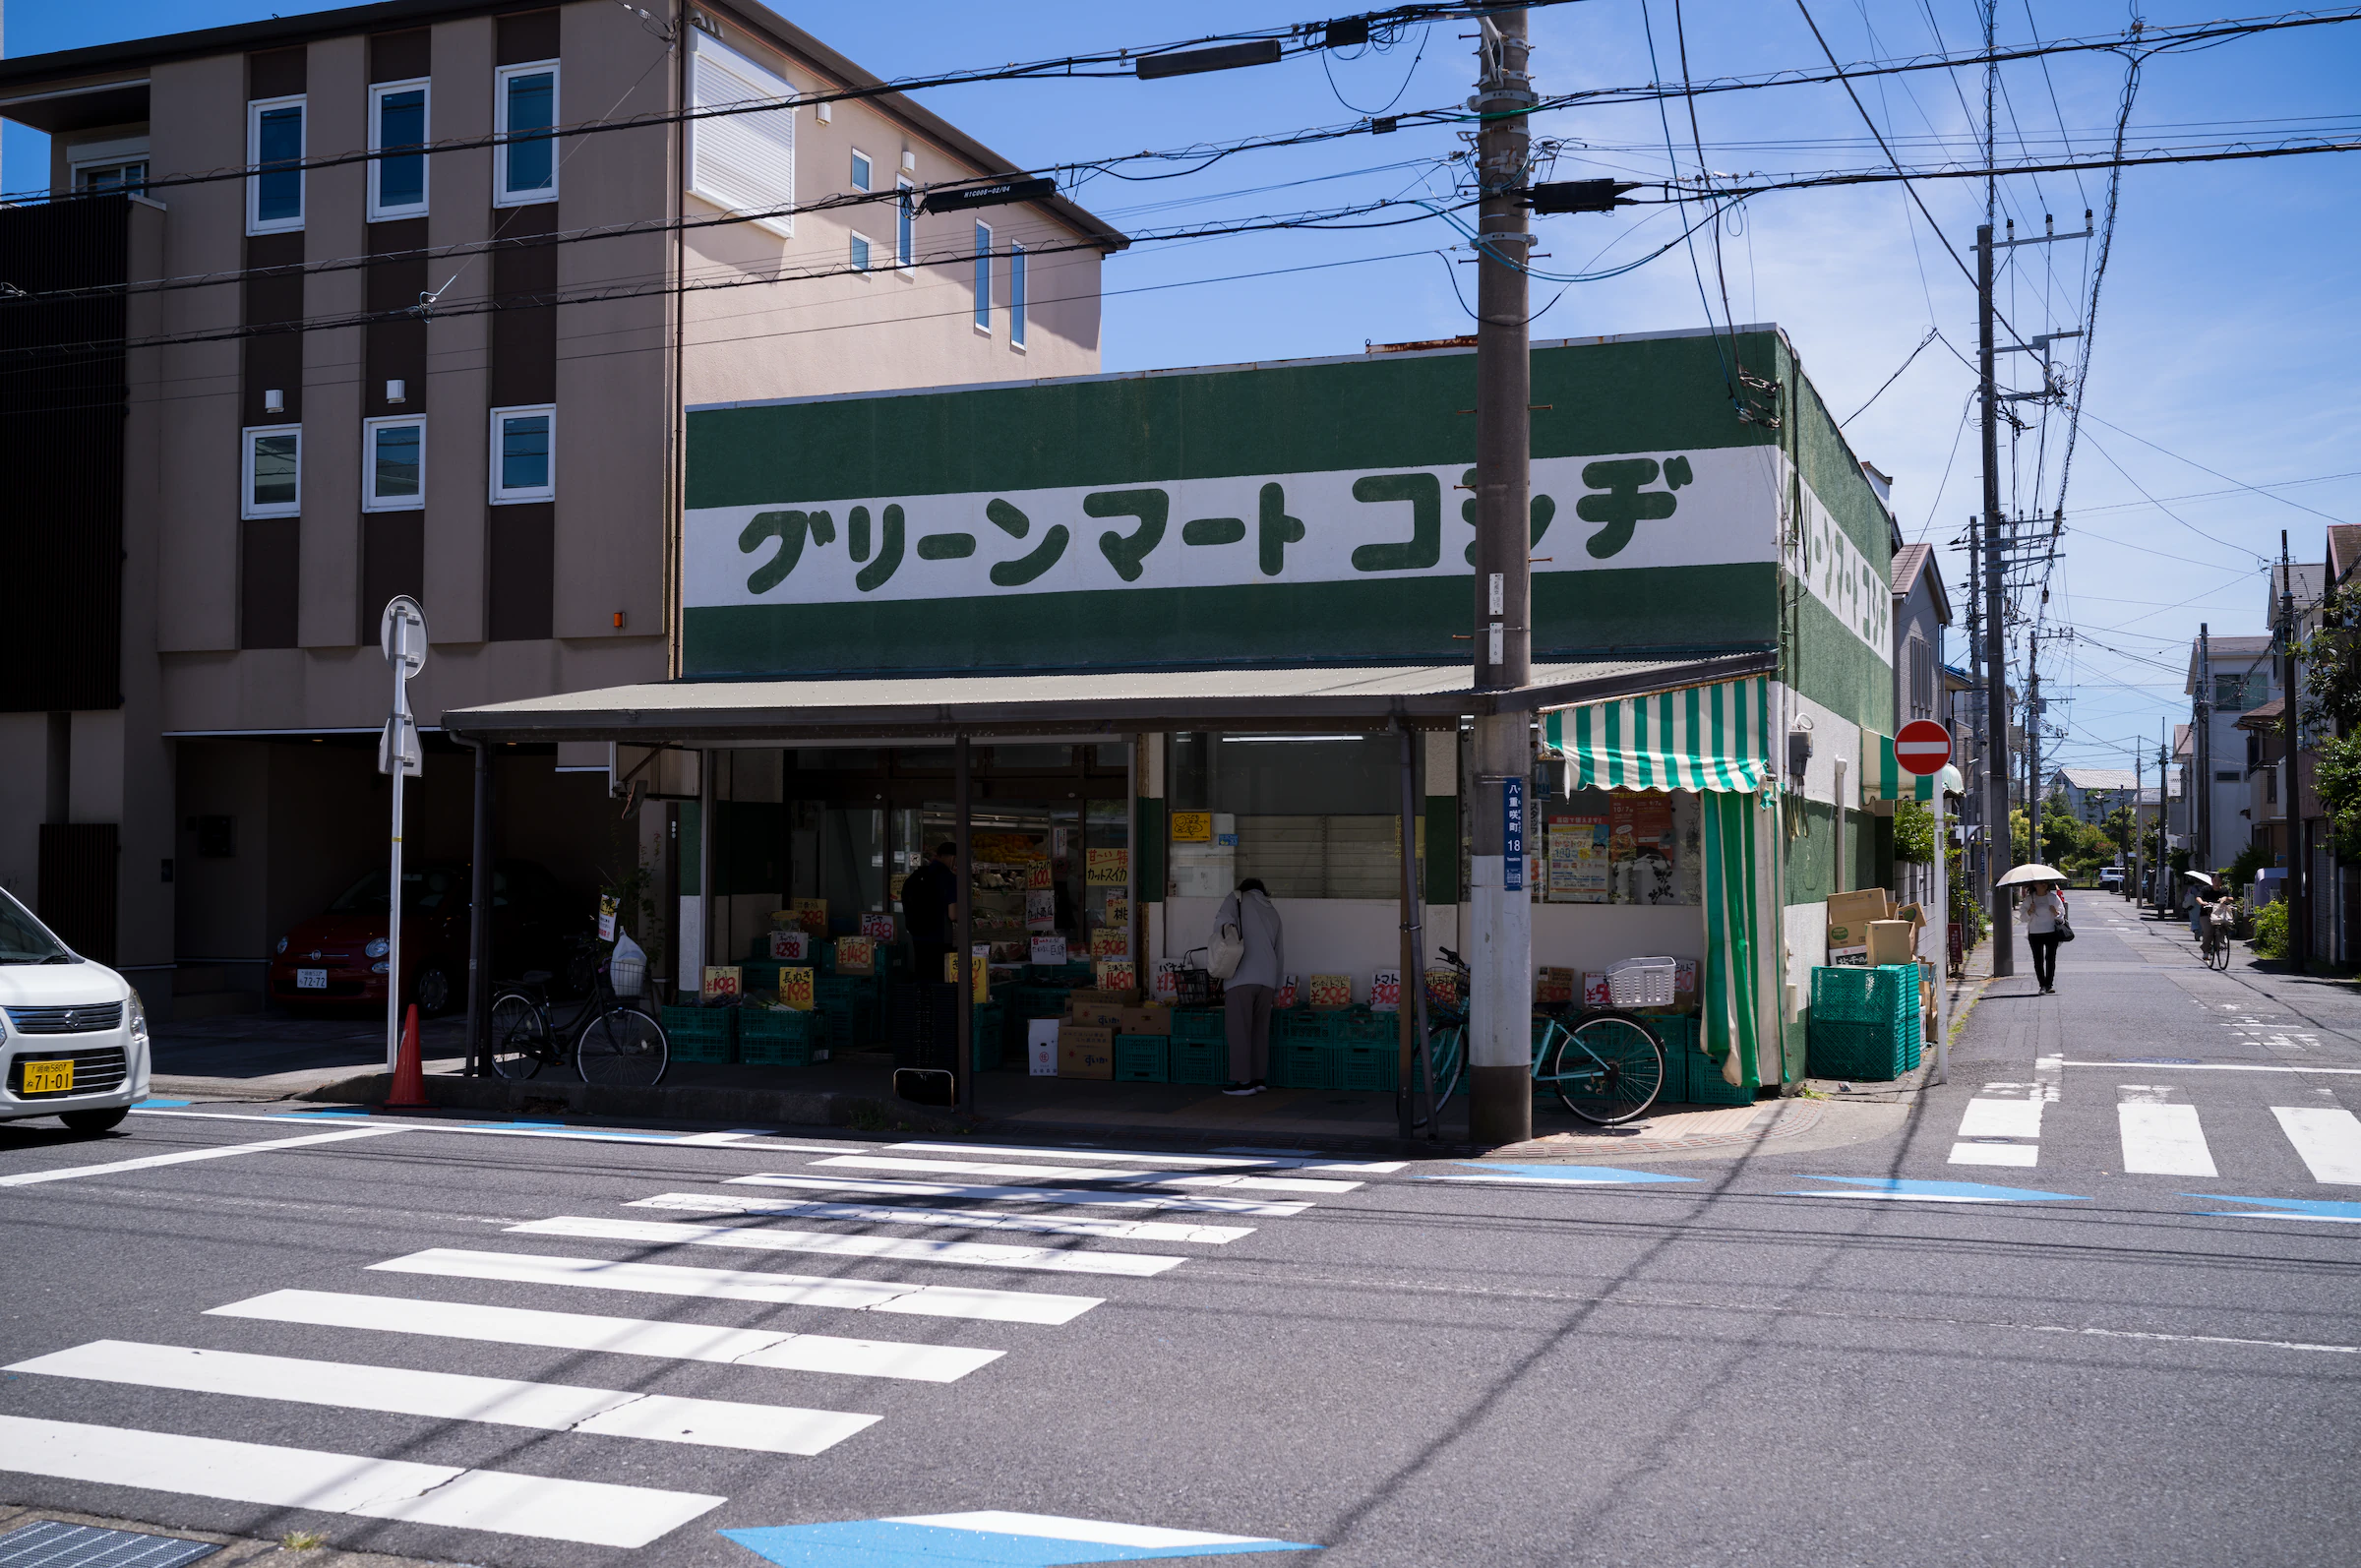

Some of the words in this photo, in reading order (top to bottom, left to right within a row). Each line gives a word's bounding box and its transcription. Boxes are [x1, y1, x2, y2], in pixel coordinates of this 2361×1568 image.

[738, 481, 1306, 595] グリーンマート
[1508, 784, 1519, 832] 八重咲町
[1507, 839, 1521, 852] 18
[1087, 867, 1127, 882] カットスイカ
[865, 914, 883, 923] ゴーヤ
[863, 922, 892, 939] ¥138
[839, 943, 870, 964] ¥148
[304, 977, 326, 987] 72-72
[783, 969, 814, 984] 長ねぎ
[1098, 972, 1134, 990] ¥1480
[1374, 973, 1399, 985] トマト
[706, 977, 737, 995] ¥198
[780, 982, 812, 1002] ¥198
[1310, 986, 1351, 1005] ¥298
[1097, 1014, 1120, 1025] すいか
[1084, 1055, 1108, 1066] すいか
[35, 1073, 69, 1090] 71-01
